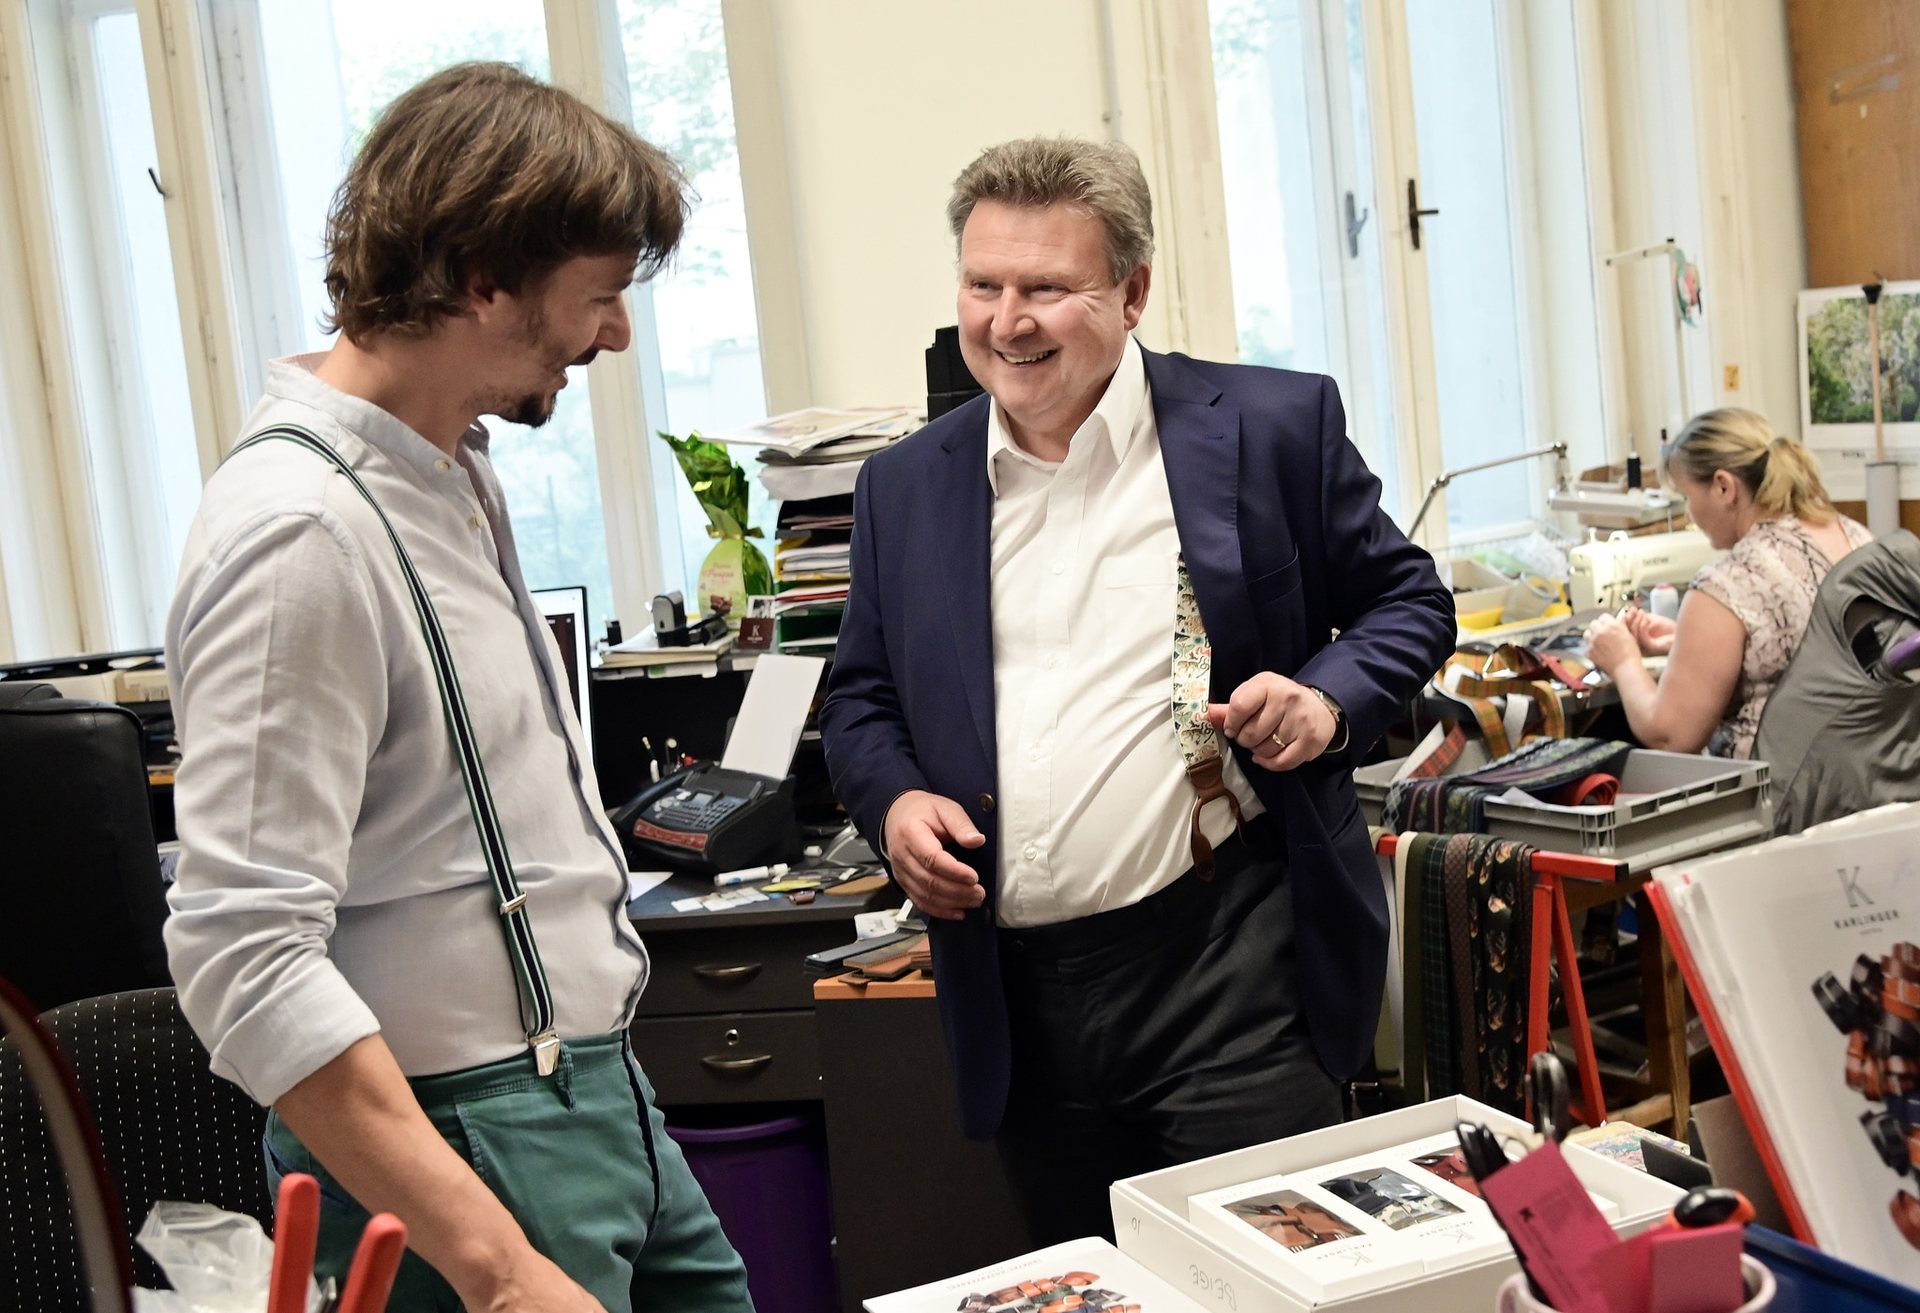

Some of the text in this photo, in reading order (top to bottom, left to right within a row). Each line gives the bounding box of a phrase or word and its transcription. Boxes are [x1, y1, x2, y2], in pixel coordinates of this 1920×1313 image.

[1837, 865, 1875, 908] K
[1834, 909, 1899, 929] KARLINGER
[1189, 1264, 1237, 1312] BEIGE
